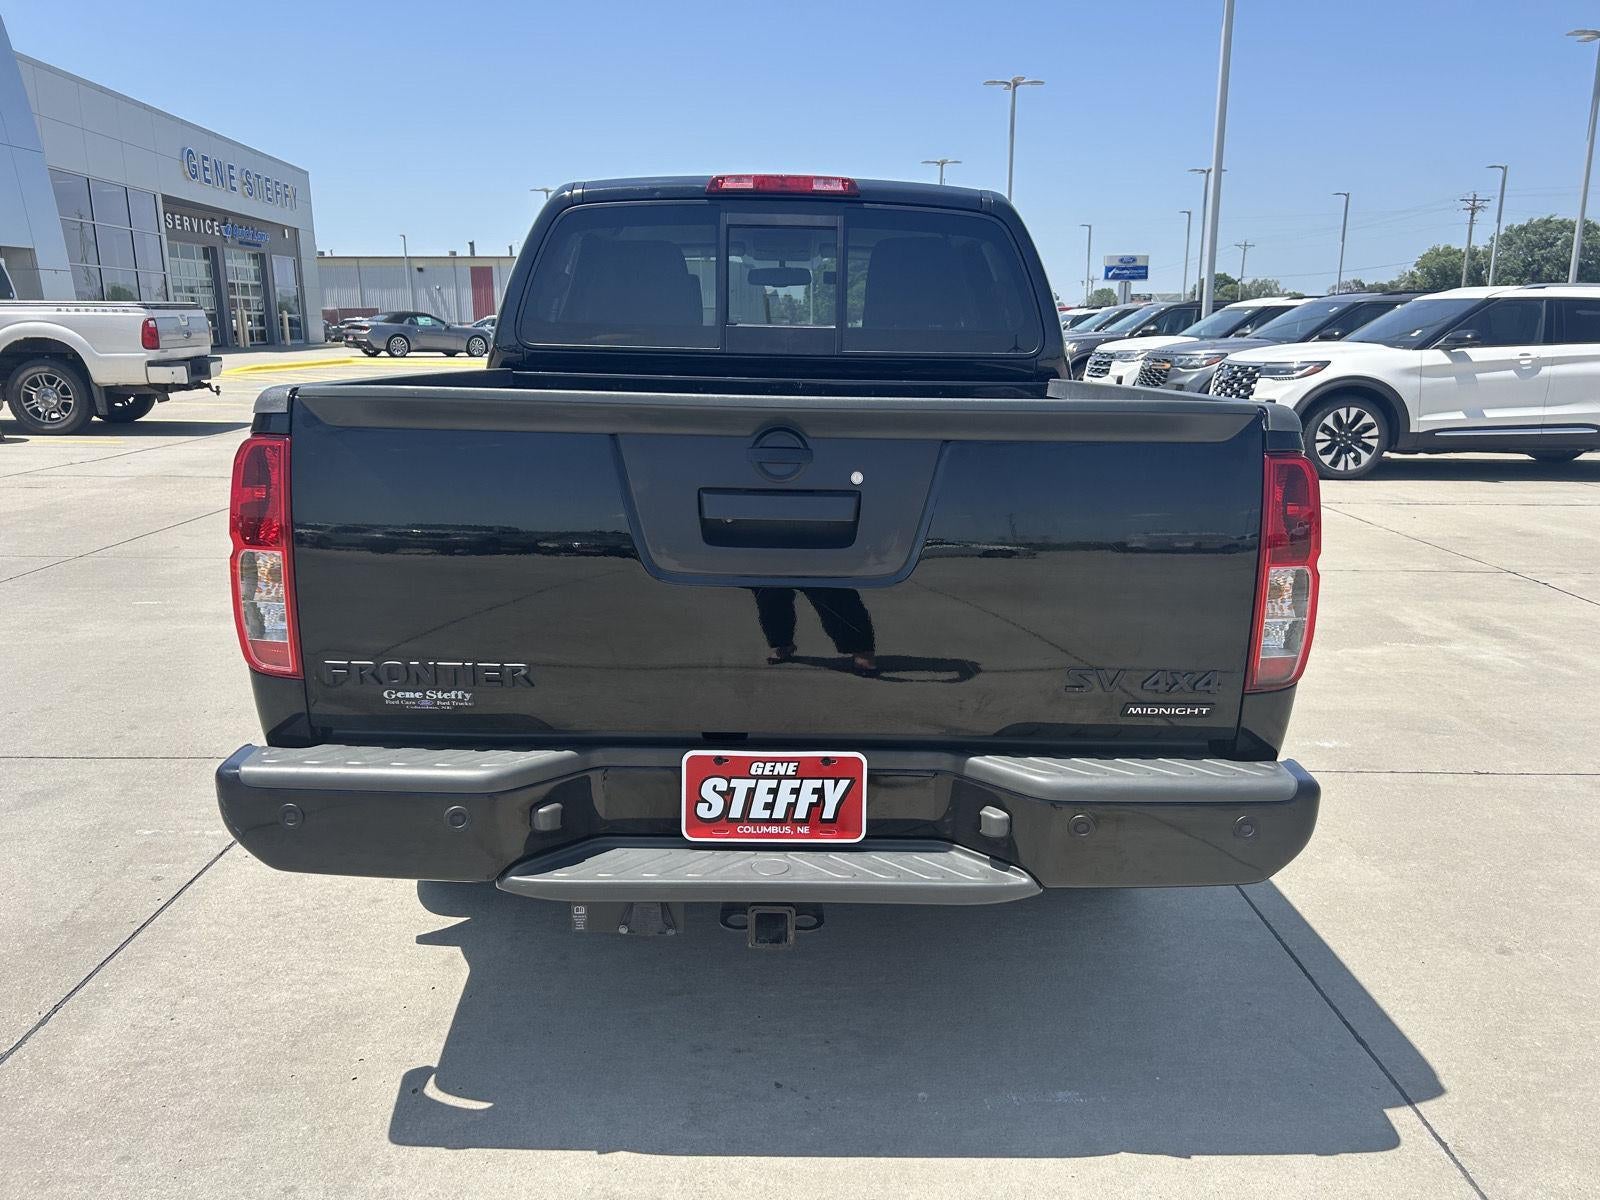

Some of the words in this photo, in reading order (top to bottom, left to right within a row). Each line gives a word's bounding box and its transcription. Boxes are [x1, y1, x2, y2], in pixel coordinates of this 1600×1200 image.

[182, 147, 237, 193] GENE
[242, 168, 297, 210] STEFFY
[165, 213, 220, 236] SERVICE
[323, 660, 534, 687] FRONTIER
[1065, 666, 1125, 692] SV
[383, 689, 423, 700] Gene
[425, 689, 472, 701] Steffy
[1127, 707, 1210, 715] MIDNIGHT
[749, 761, 799, 776] GENE
[696, 776, 853, 820] STEFFY
[737, 825, 794, 835] COLUMBUS,
[797, 826, 810, 834] NE
